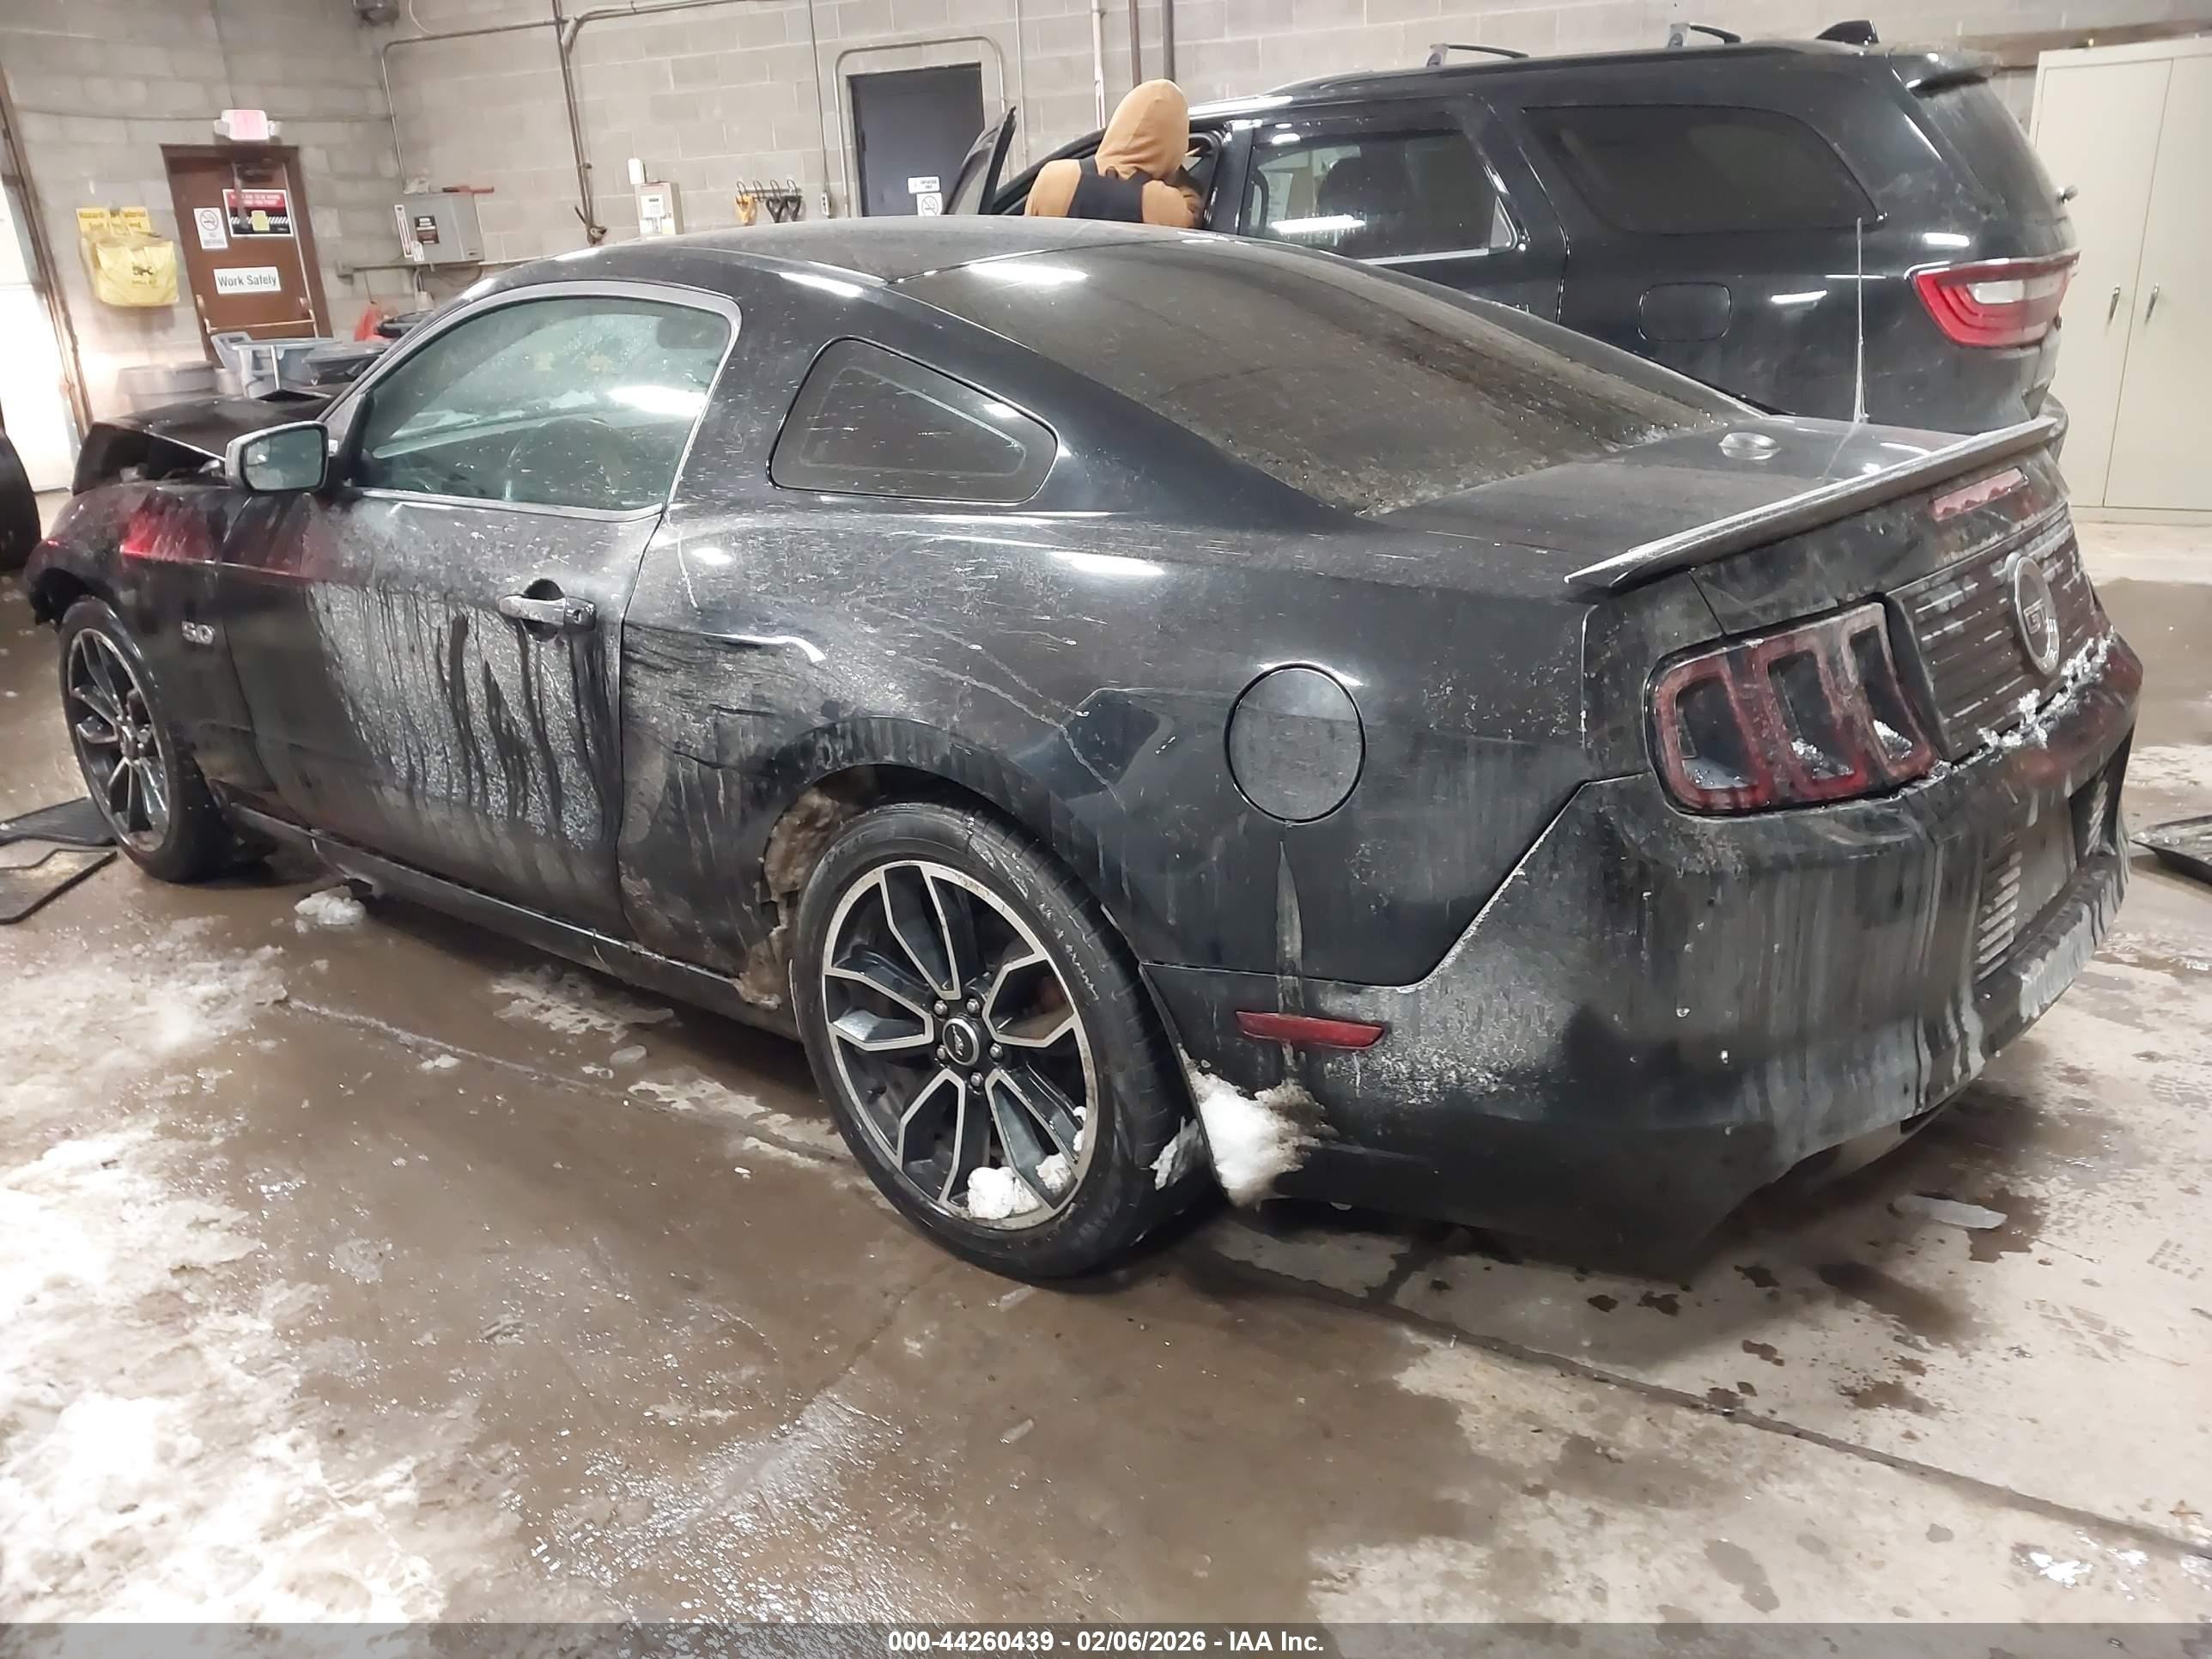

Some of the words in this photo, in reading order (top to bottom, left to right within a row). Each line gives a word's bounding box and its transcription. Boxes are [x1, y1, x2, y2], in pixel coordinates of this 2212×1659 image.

[217, 275, 244, 287] Work
[246, 274, 276, 286] Safely
[2023, 598, 2048, 634] GT
